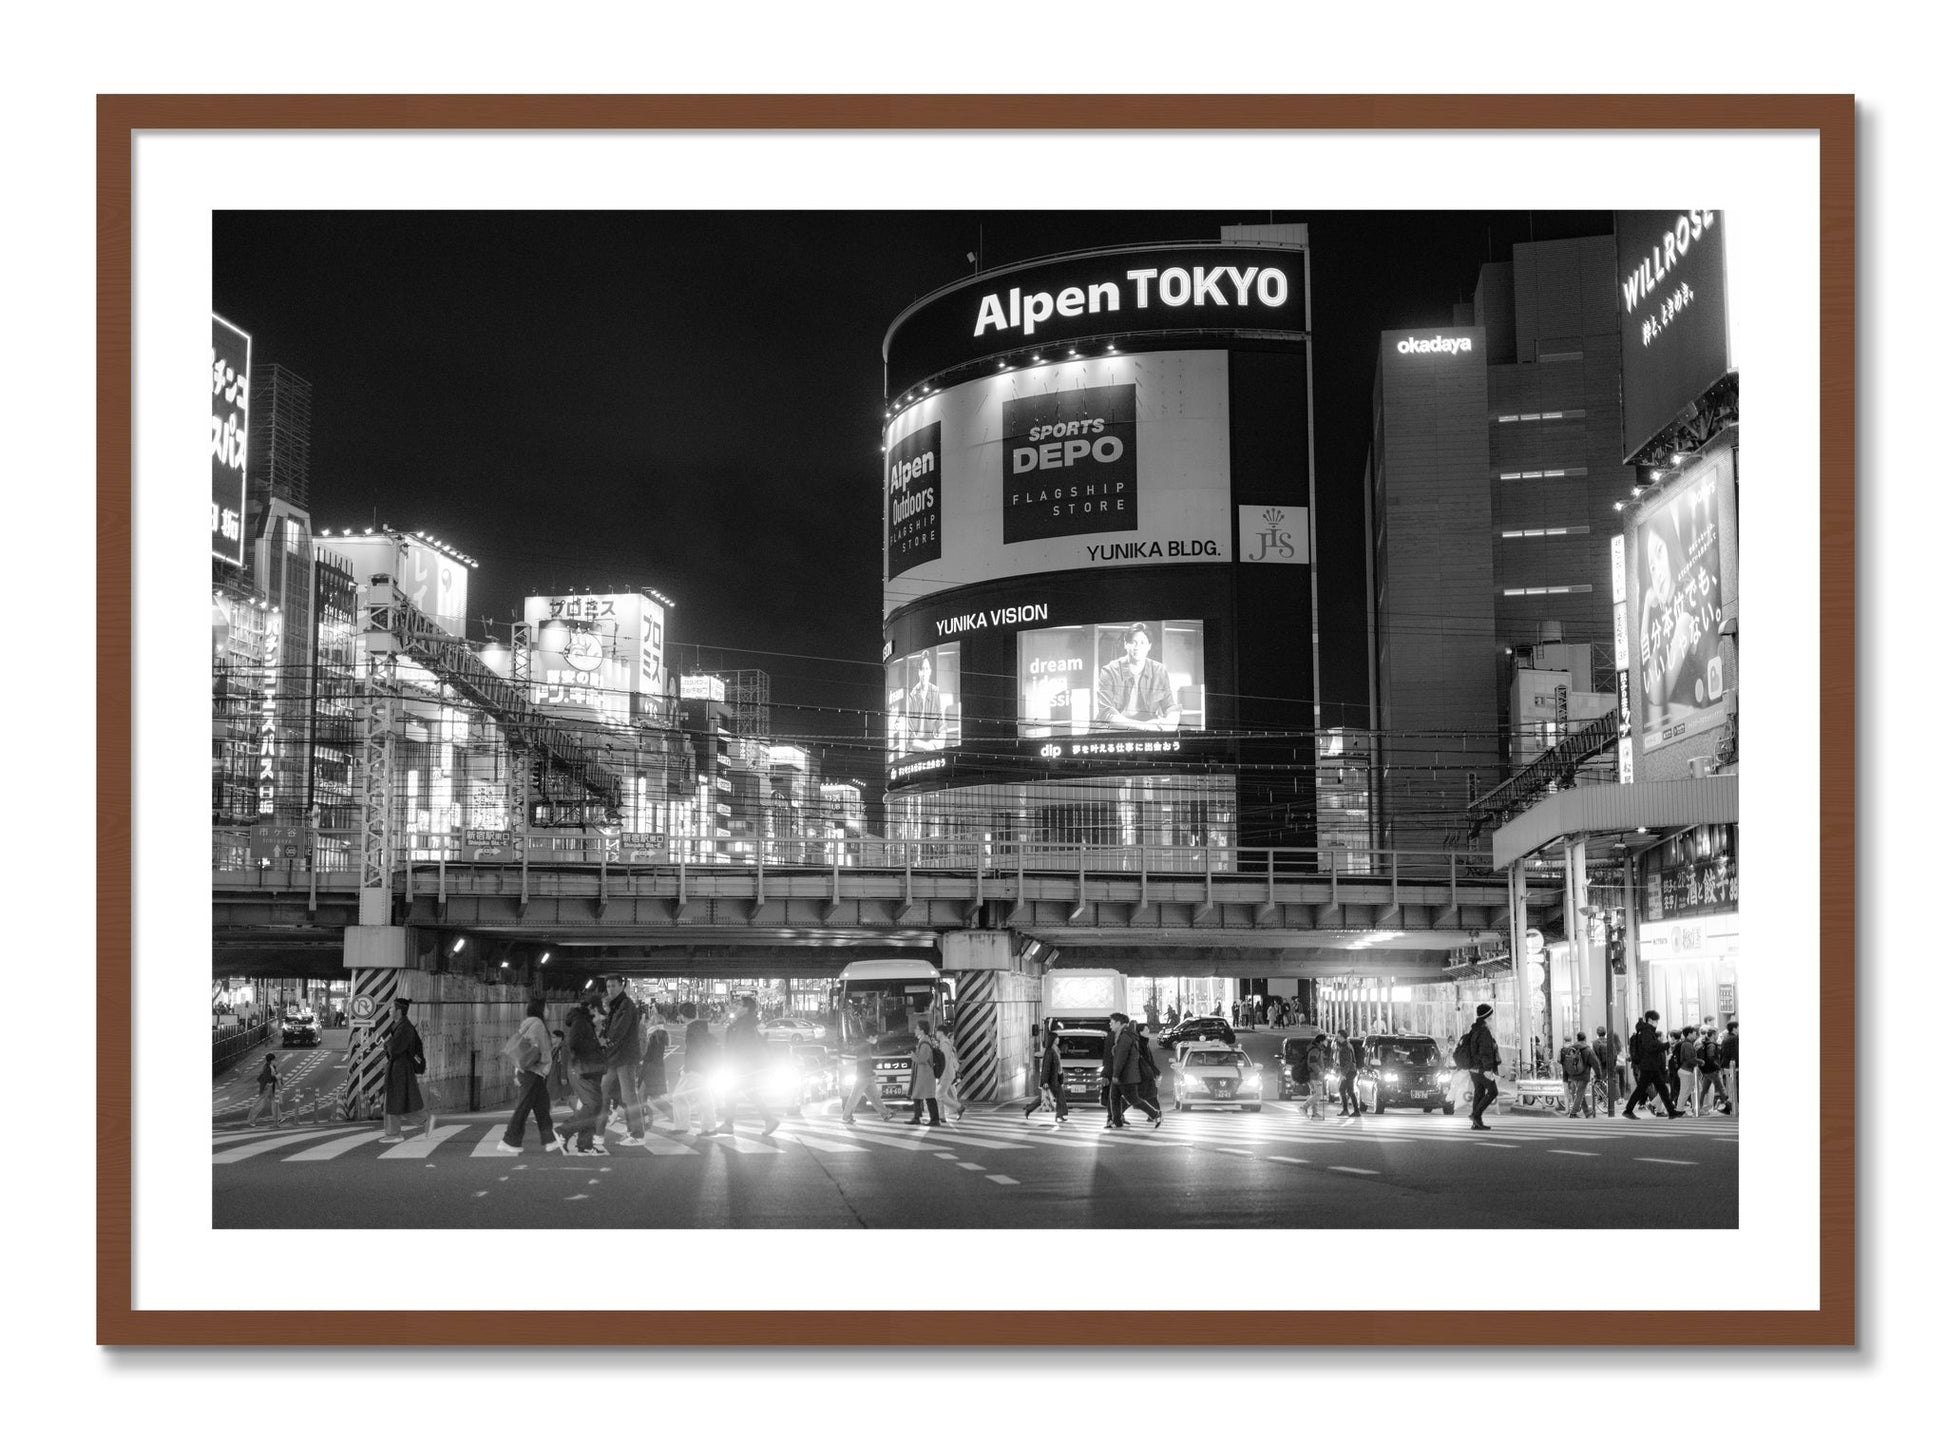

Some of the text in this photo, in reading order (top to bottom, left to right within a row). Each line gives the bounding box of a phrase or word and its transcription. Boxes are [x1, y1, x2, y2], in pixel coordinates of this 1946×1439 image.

[973, 266, 1288, 337] Alpen TOKYO
[1397, 335, 1472, 355] okadaya
[212, 347, 247, 411] チンコ
[1028, 417, 1105, 442] SPORTS
[1013, 436, 1124, 474] DEPO
[890, 451, 934, 494] Alpen
[893, 487, 934, 526] Outdoors
[1013, 482, 1125, 505] FLAGSHIP
[1053, 499, 1125, 516] STORE
[890, 514, 935, 547] FLAGSHIP
[902, 530, 935, 553] STORE
[1087, 540, 1221, 562] YUNIKA BLDG.
[550, 598, 616, 618] プロミス
[936, 603, 1048, 636] YUNIKA VISION
[1640, 566, 1718, 665] 自分本位でも、
[1643, 604, 1722, 694] いいじゃない。
[1030, 657, 1083, 674] dream
[1040, 744, 1062, 758] dip
